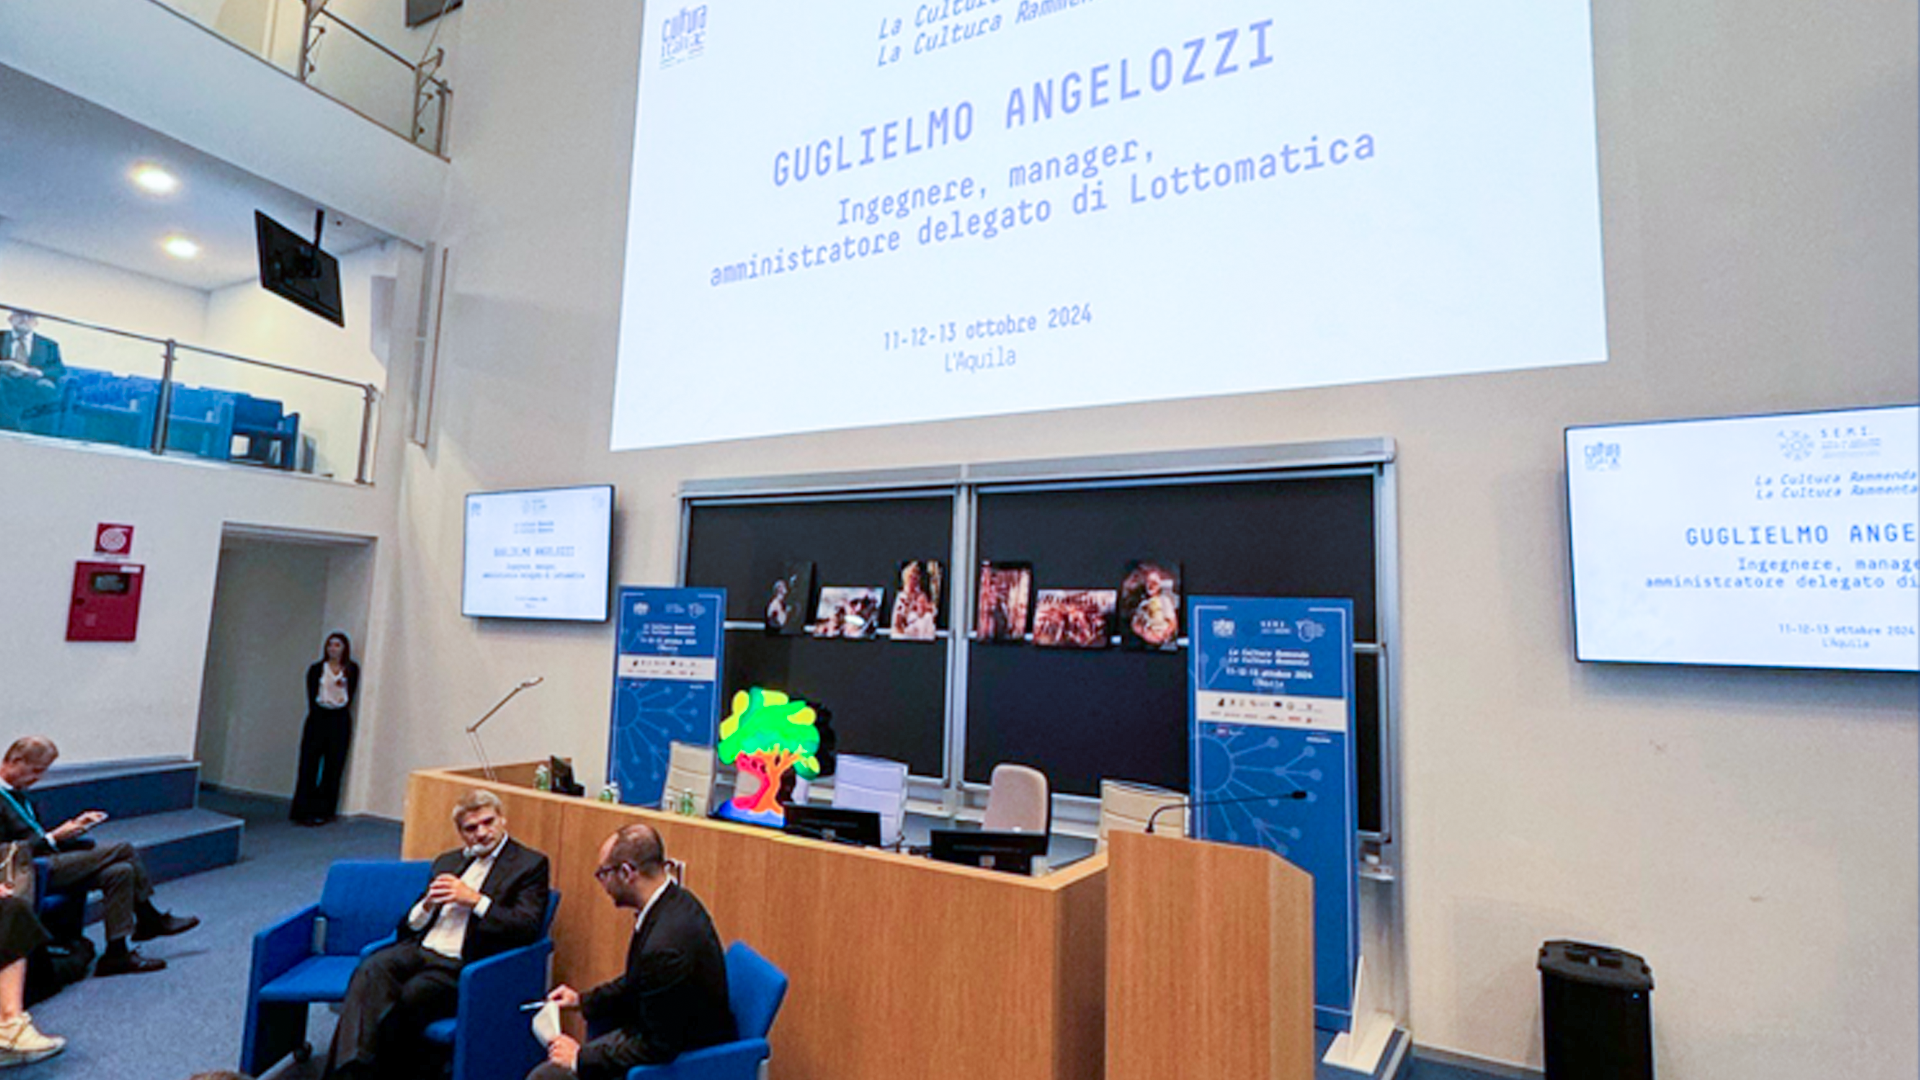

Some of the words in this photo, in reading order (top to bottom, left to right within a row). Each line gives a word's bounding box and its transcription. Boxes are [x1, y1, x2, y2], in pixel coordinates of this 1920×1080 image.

[877, 46, 901, 67] La
[913, 14, 1002, 55] Cultura
[878, 18, 902, 40] La
[773, 101, 974, 187] GUGLIELMO
[1005, 19, 1274, 129] ANGELOZZI
[838, 177, 987, 226] Ingegnere,
[1009, 139, 1153, 188] manager,
[710, 230, 901, 286] amministratore
[918, 199, 1051, 246] delegato
[1072, 180, 1108, 216] di
[1130, 133, 1376, 204] Lottomatica
[884, 322, 957, 351] 11-12-13
[966, 314, 1037, 340] ottobre
[1047, 303, 1092, 329] 2024
[945, 347, 1016, 374] L'Aquila
[1780, 473, 1841, 485] Cultura
[1781, 487, 1842, 498] Cultura
[1685, 525, 1829, 546] GUGLIELMO
[1849, 523, 1915, 543] ANGE
[1738, 556, 1841, 574] Ingegnere,
[1645, 574, 1785, 588] amministratore
[1796, 574, 1884, 591] delegato
